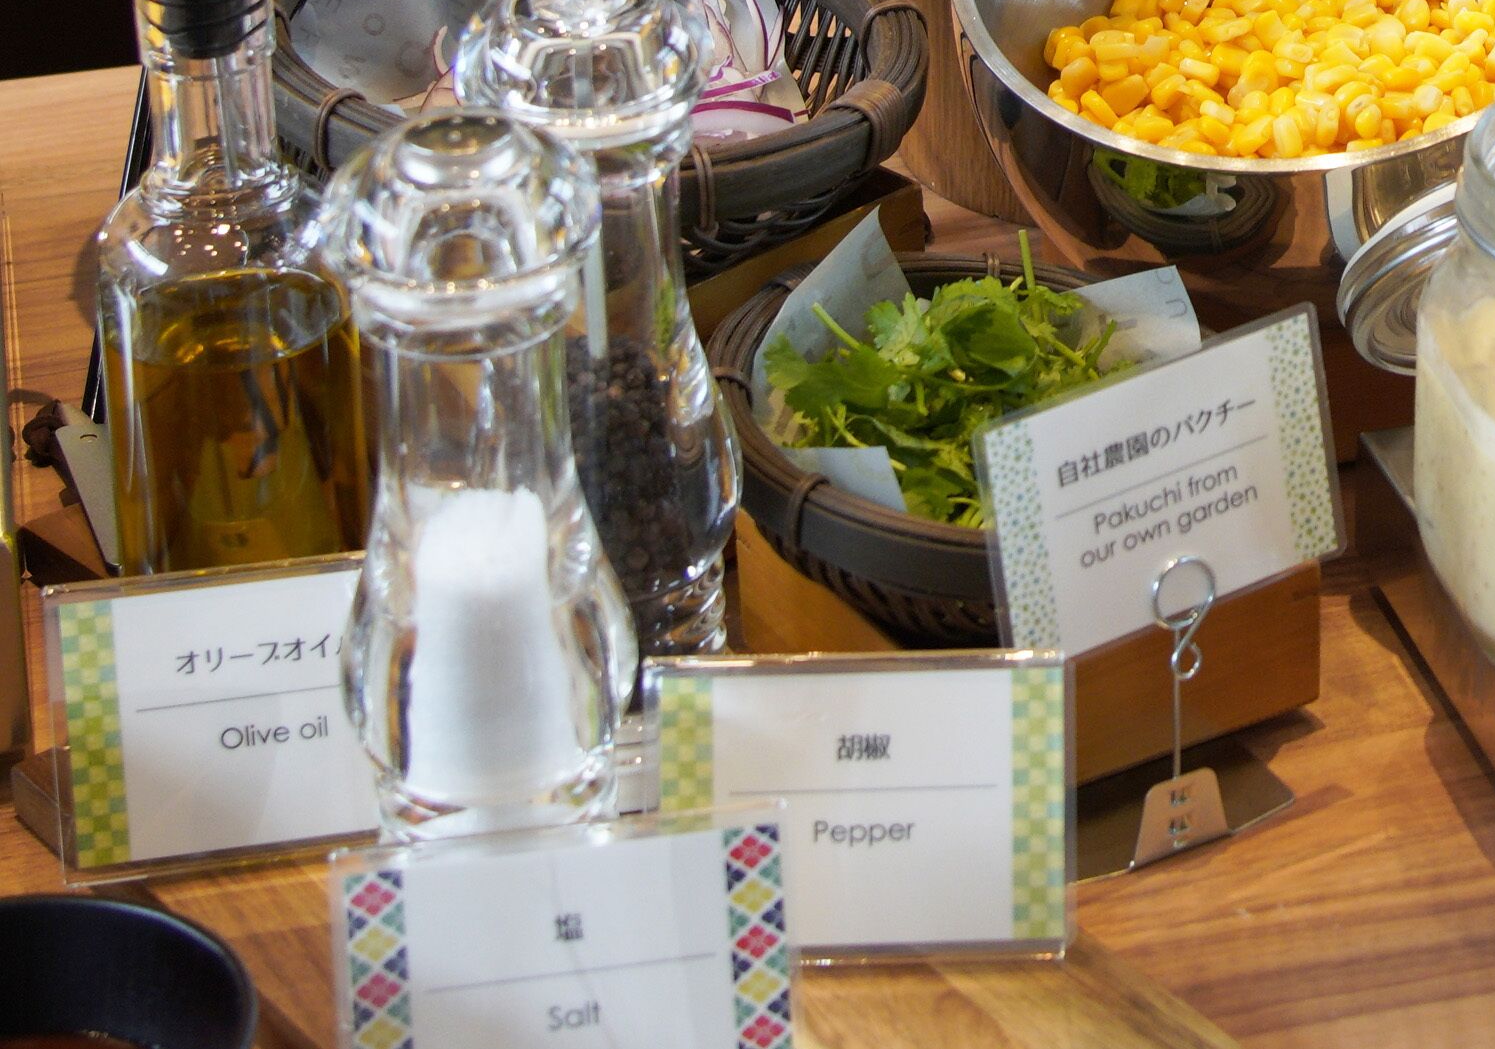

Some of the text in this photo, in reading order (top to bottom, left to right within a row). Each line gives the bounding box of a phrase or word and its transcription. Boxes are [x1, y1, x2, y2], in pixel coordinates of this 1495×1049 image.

[1056, 398, 1257, 488] 自社農園のパクチー
[1093, 465, 1239, 534] Pakuchi from
[1079, 483, 1259, 569] our own garden
[220, 715, 329, 750] Olive oil
[836, 733, 891, 760] 胡椒
[813, 819, 915, 847] Pepper
[547, 1001, 600, 1032] Salt
